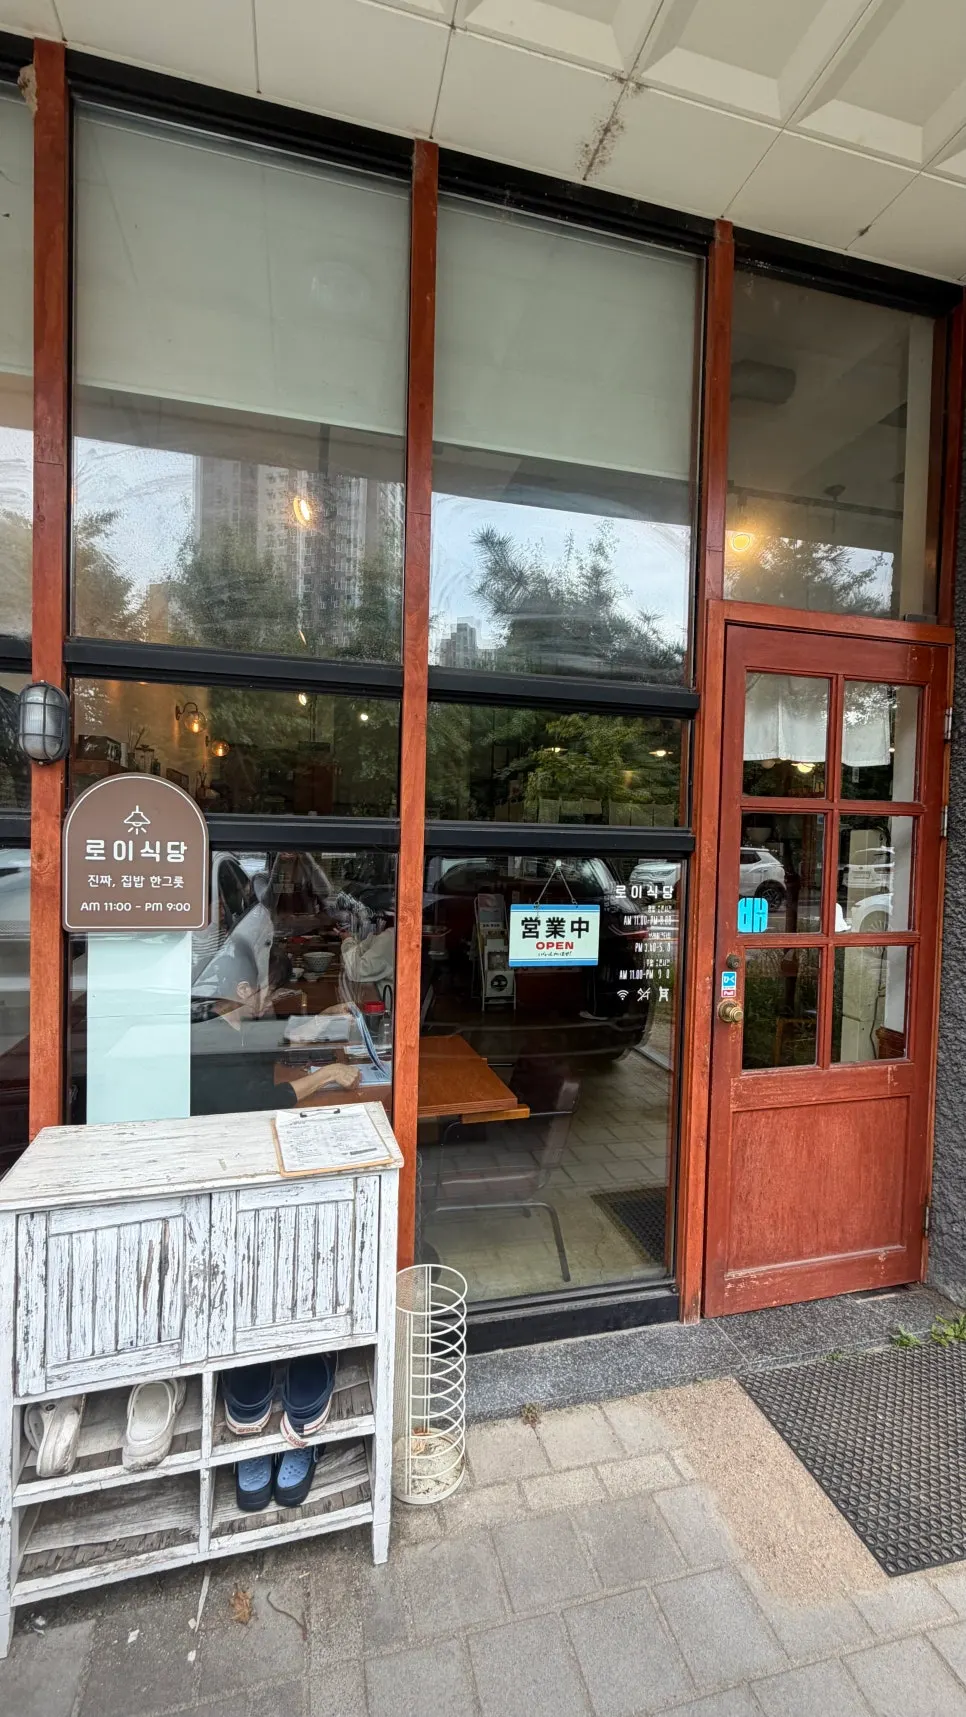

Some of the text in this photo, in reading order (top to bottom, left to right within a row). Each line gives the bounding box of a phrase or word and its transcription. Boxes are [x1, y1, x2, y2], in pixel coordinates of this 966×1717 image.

[87, 874, 185, 889] 진짜, 집밥 한그릇
[104, 902, 132, 912] 11:00
[166, 902, 191, 912] 9:00
[521, 916, 590, 939] 営業中
[535, 941, 574, 950] OPEN
